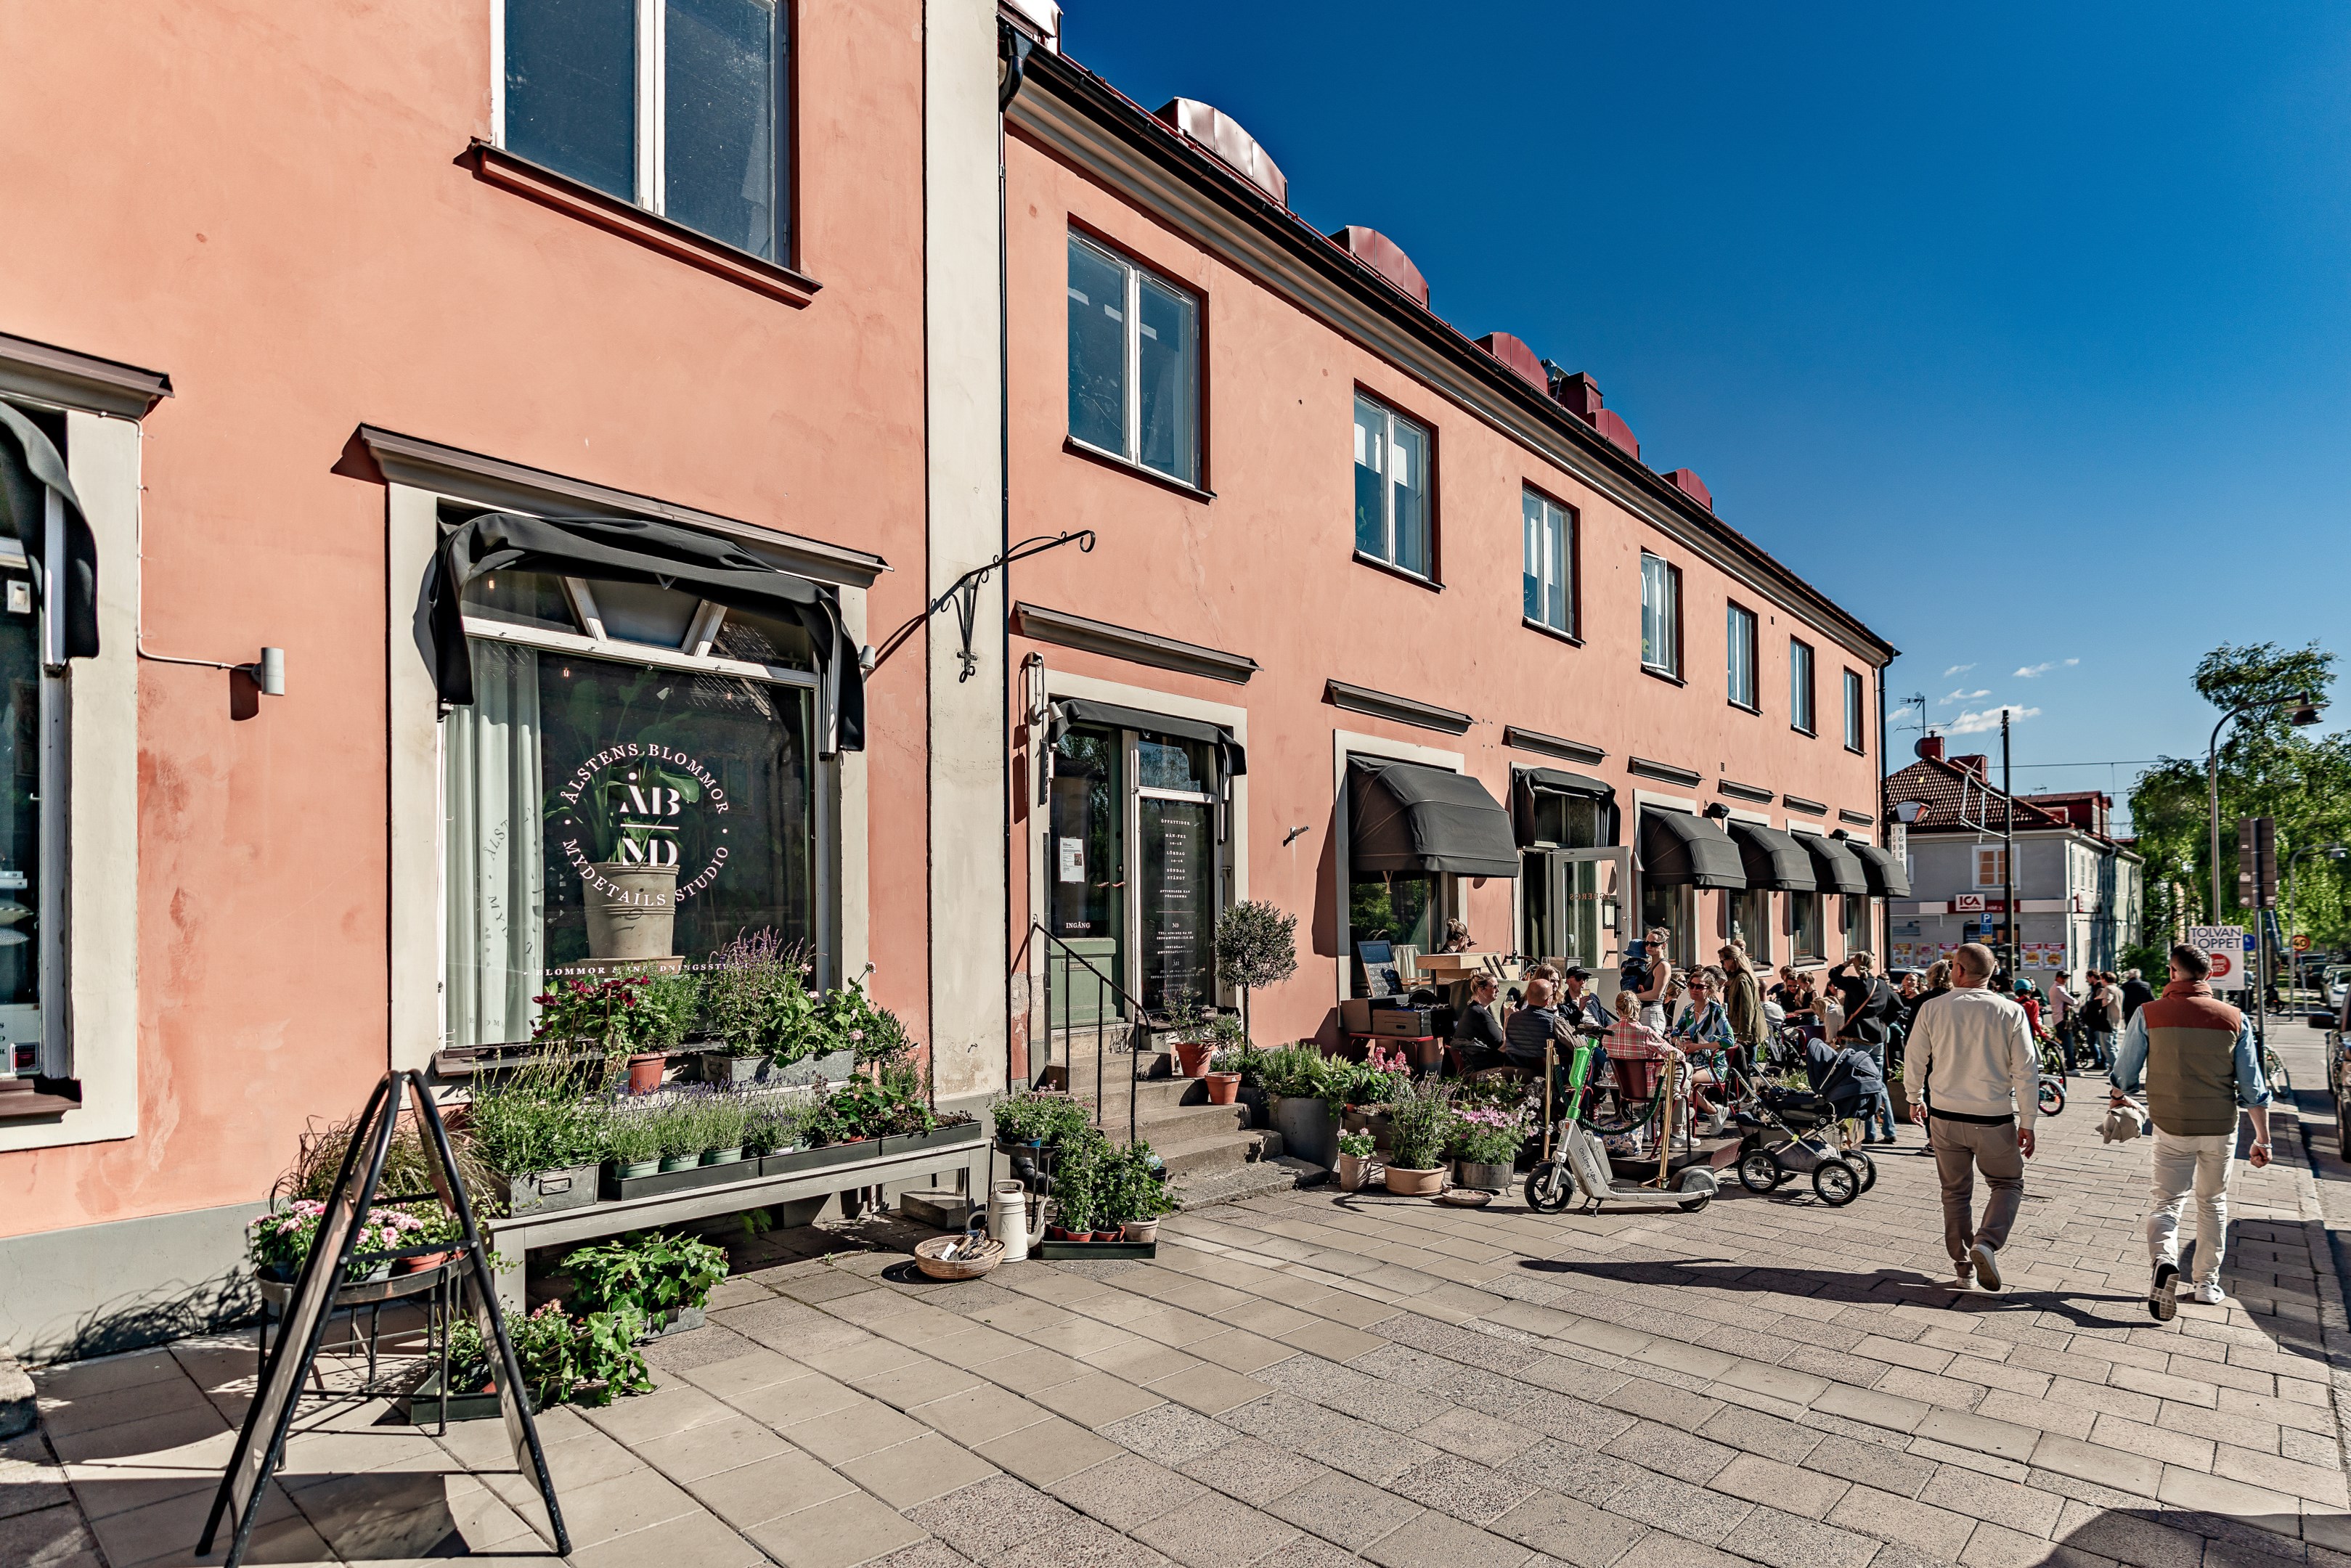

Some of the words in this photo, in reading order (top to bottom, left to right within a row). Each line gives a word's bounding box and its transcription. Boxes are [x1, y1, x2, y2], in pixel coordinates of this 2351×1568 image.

[561, 743, 638, 804] ÅLSTENS
[648, 743, 728, 814] BLOMMOR
[675, 846, 728, 902] STUDIO
[1960, 896, 1981, 905] ICA
[1984, 914, 1990, 923] P
[2191, 928, 2241, 937] TOLVAN
[536, 967, 606, 976] BLOMMOR
